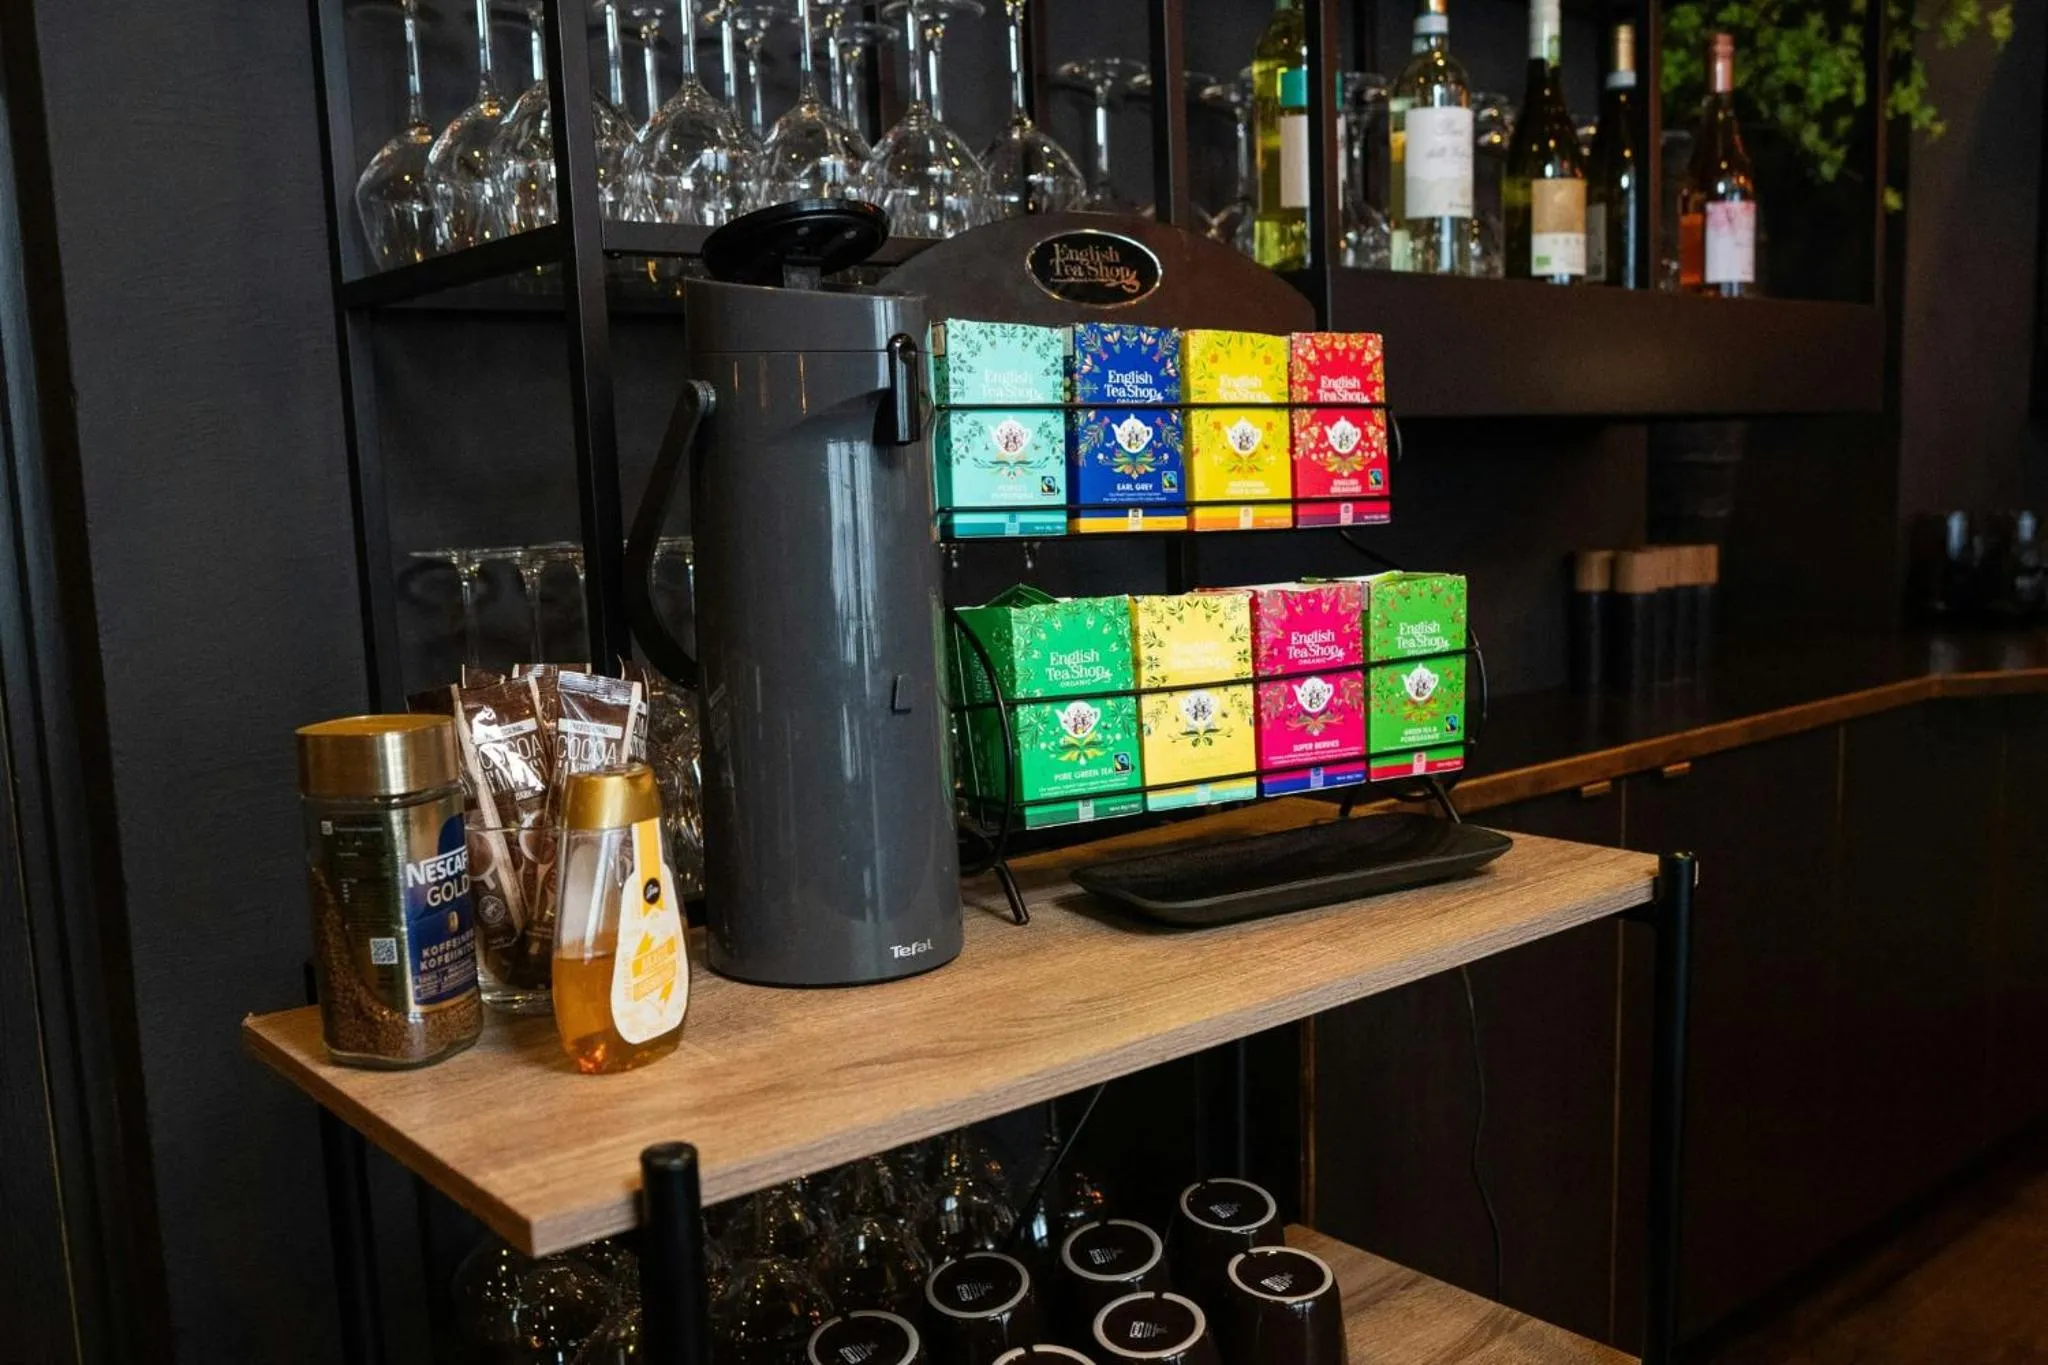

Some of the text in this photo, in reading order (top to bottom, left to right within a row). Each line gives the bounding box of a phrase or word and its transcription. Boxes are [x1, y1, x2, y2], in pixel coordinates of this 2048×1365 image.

[1051, 243, 1121, 265] English
[1050, 259, 1085, 278] Tea
[1107, 370, 1153, 387] English
[1320, 375, 1361, 390] English
[1104, 384, 1161, 401] Tea Shop
[1317, 389, 1337, 402] Tea
[1116, 482, 1153, 491] EARL GREY
[1399, 620, 1440, 637] English
[1290, 629, 1335, 647] English
[1396, 636, 1416, 649] Tea
[1049, 649, 1100, 667] English
[1286, 644, 1344, 662] Tea Shop
[1045, 664, 1112, 683] Tea Shop
[1060, 679, 1092, 688] ORGANIC
[556, 735, 617, 766] COCOA
[1054, 767, 1114, 781] PURE GREEN TEA
[406, 847, 469, 888] NESCAF
[426, 873, 470, 907] GOLD
[889, 938, 934, 959] Tefal
